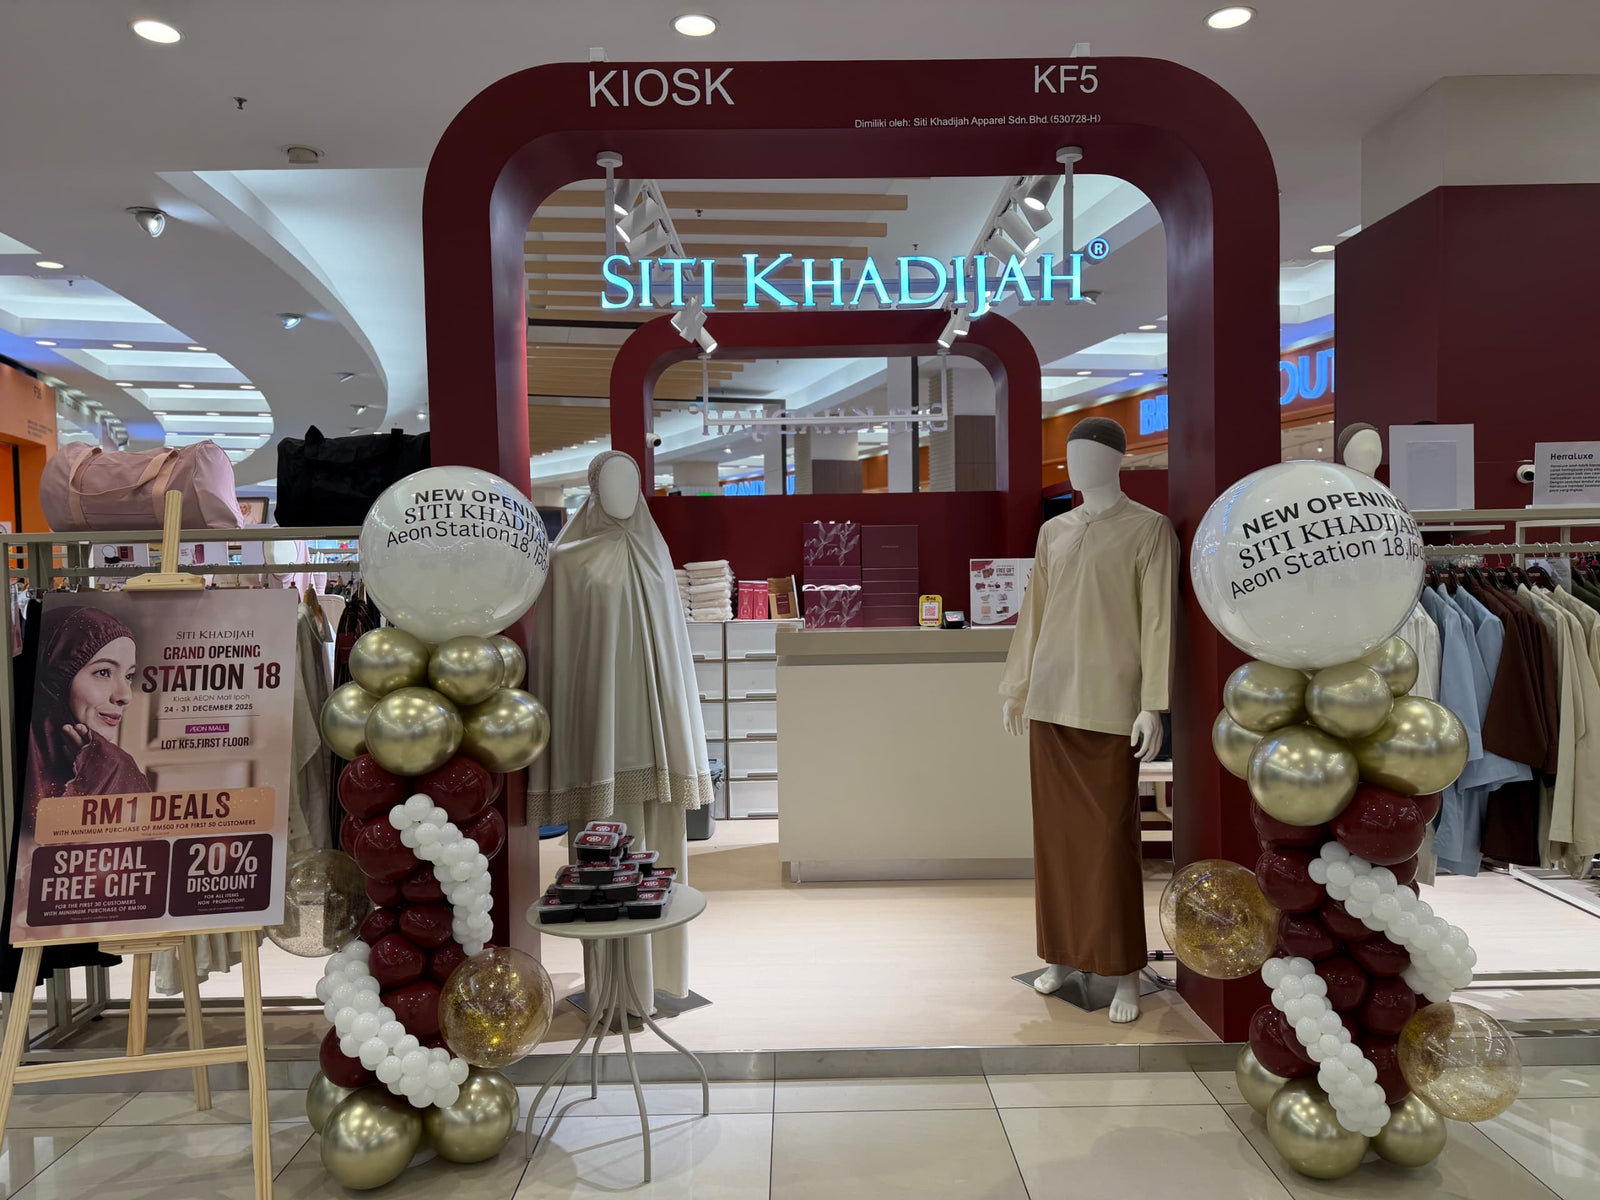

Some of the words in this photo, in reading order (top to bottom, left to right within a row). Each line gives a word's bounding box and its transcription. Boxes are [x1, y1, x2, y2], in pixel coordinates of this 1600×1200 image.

[589, 67, 735, 108] KIOSK
[1034, 65, 1099, 94] KF5
[854, 119, 887, 129] Dimiliki
[889, 118, 911, 128] oleh:
[913, 117, 928, 127] Siti
[930, 116, 969, 128] Khadijah
[971, 116, 1006, 127] Apparel
[1008, 115, 1028, 125] Sdn.
[1029, 115, 1049, 125] Bhd.
[1050, 114, 1101, 124] (530728-H)
[601, 254, 716, 310] SITI
[742, 252, 1085, 319] KHADIJAH
[415, 488, 464, 504] NEW
[404, 503, 452, 525] SITI
[1242, 502, 1299, 540] NEW
[1307, 491, 1409, 514] OPENING
[387, 525, 432, 548] Aeon
[435, 520, 509, 543] Station
[1239, 529, 1296, 570] SITI
[1299, 512, 1420, 545] KHADIJAH
[1231, 566, 1281, 600] Aeon
[1284, 539, 1376, 575] Station
[176, 631, 196, 640] SITI
[199, 630, 254, 640] KHADIJAH
[163, 646, 205, 660] GRAND
[208, 644, 261, 659] OPENING
[141, 663, 244, 693] STATION
[253, 662, 281, 690] 18
[192, 704, 233, 712] DECEMBER
[161, 740, 177, 750] LOT
[222, 737, 250, 747] FLOOR
[81, 796, 138, 826] RM1
[150, 792, 231, 822] DEALS
[217, 819, 256, 827] CUSTOMERS
[53, 846, 147, 875] SPECIAL
[187, 840, 258, 877] 20%
[41, 875, 97, 902] FREE
[104, 871, 156, 898] GIFT
[186, 874, 258, 894] DISCOUNT
[58, 907, 86, 915] MINIMUM
[87, 904, 117, 914] PURCHASE
[127, 901, 147, 910] RM100
